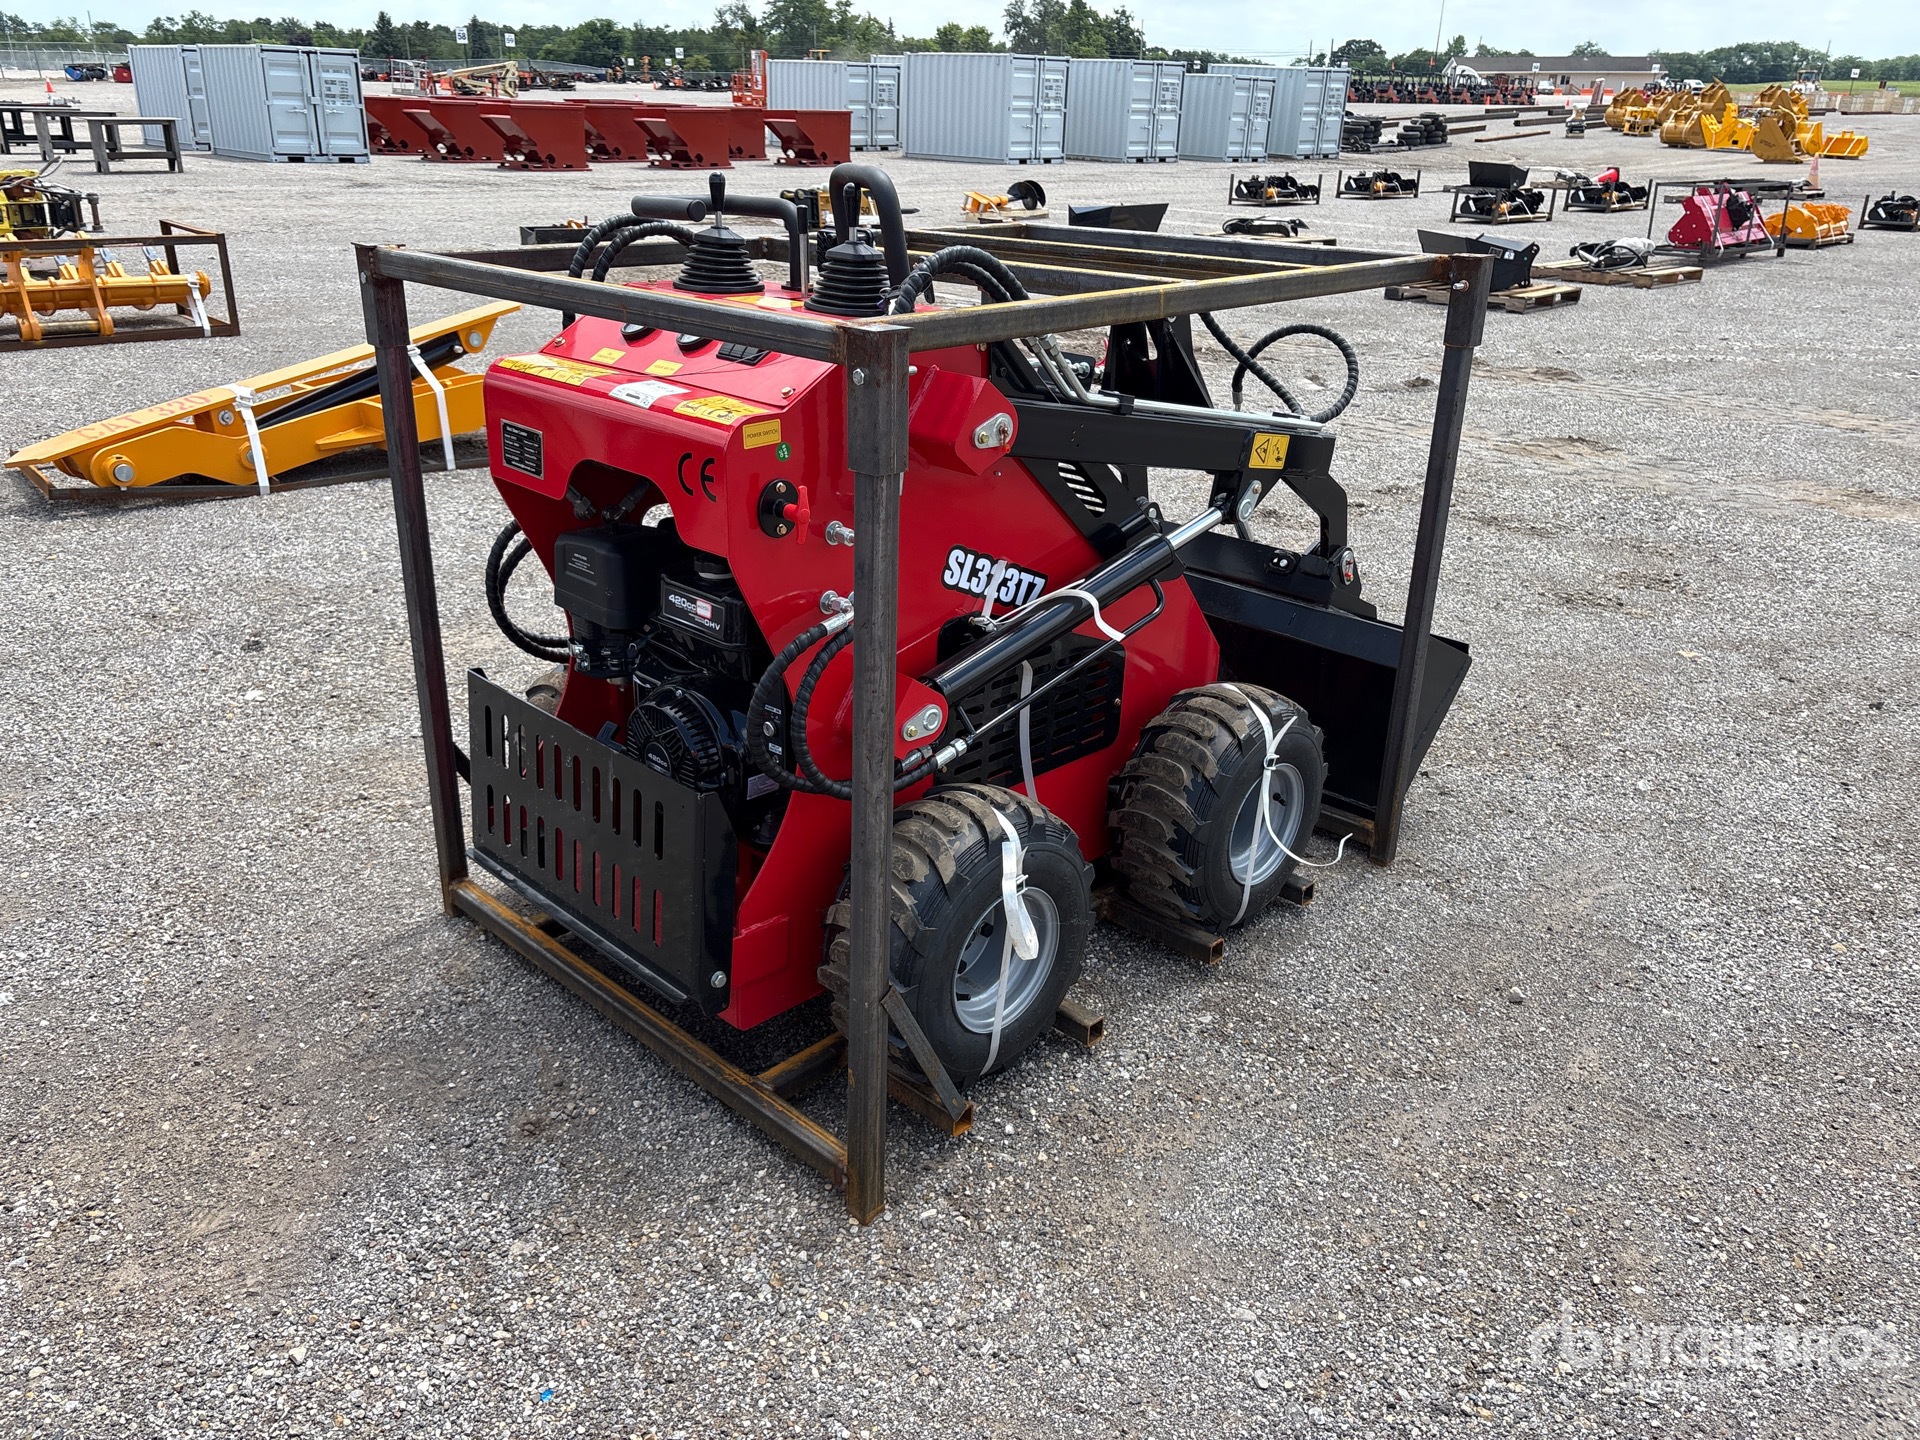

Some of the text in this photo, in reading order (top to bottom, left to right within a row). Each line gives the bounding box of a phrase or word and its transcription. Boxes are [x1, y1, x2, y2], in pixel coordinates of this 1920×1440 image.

[457, 32, 467, 40] 58
[77, 394, 211, 440] CAT 320
[747, 428, 778, 439] POWER SWITCH
[668, 594, 697, 611] 420cc
[704, 619, 721, 631] OHV
[648, 752, 668, 768] 420cc
